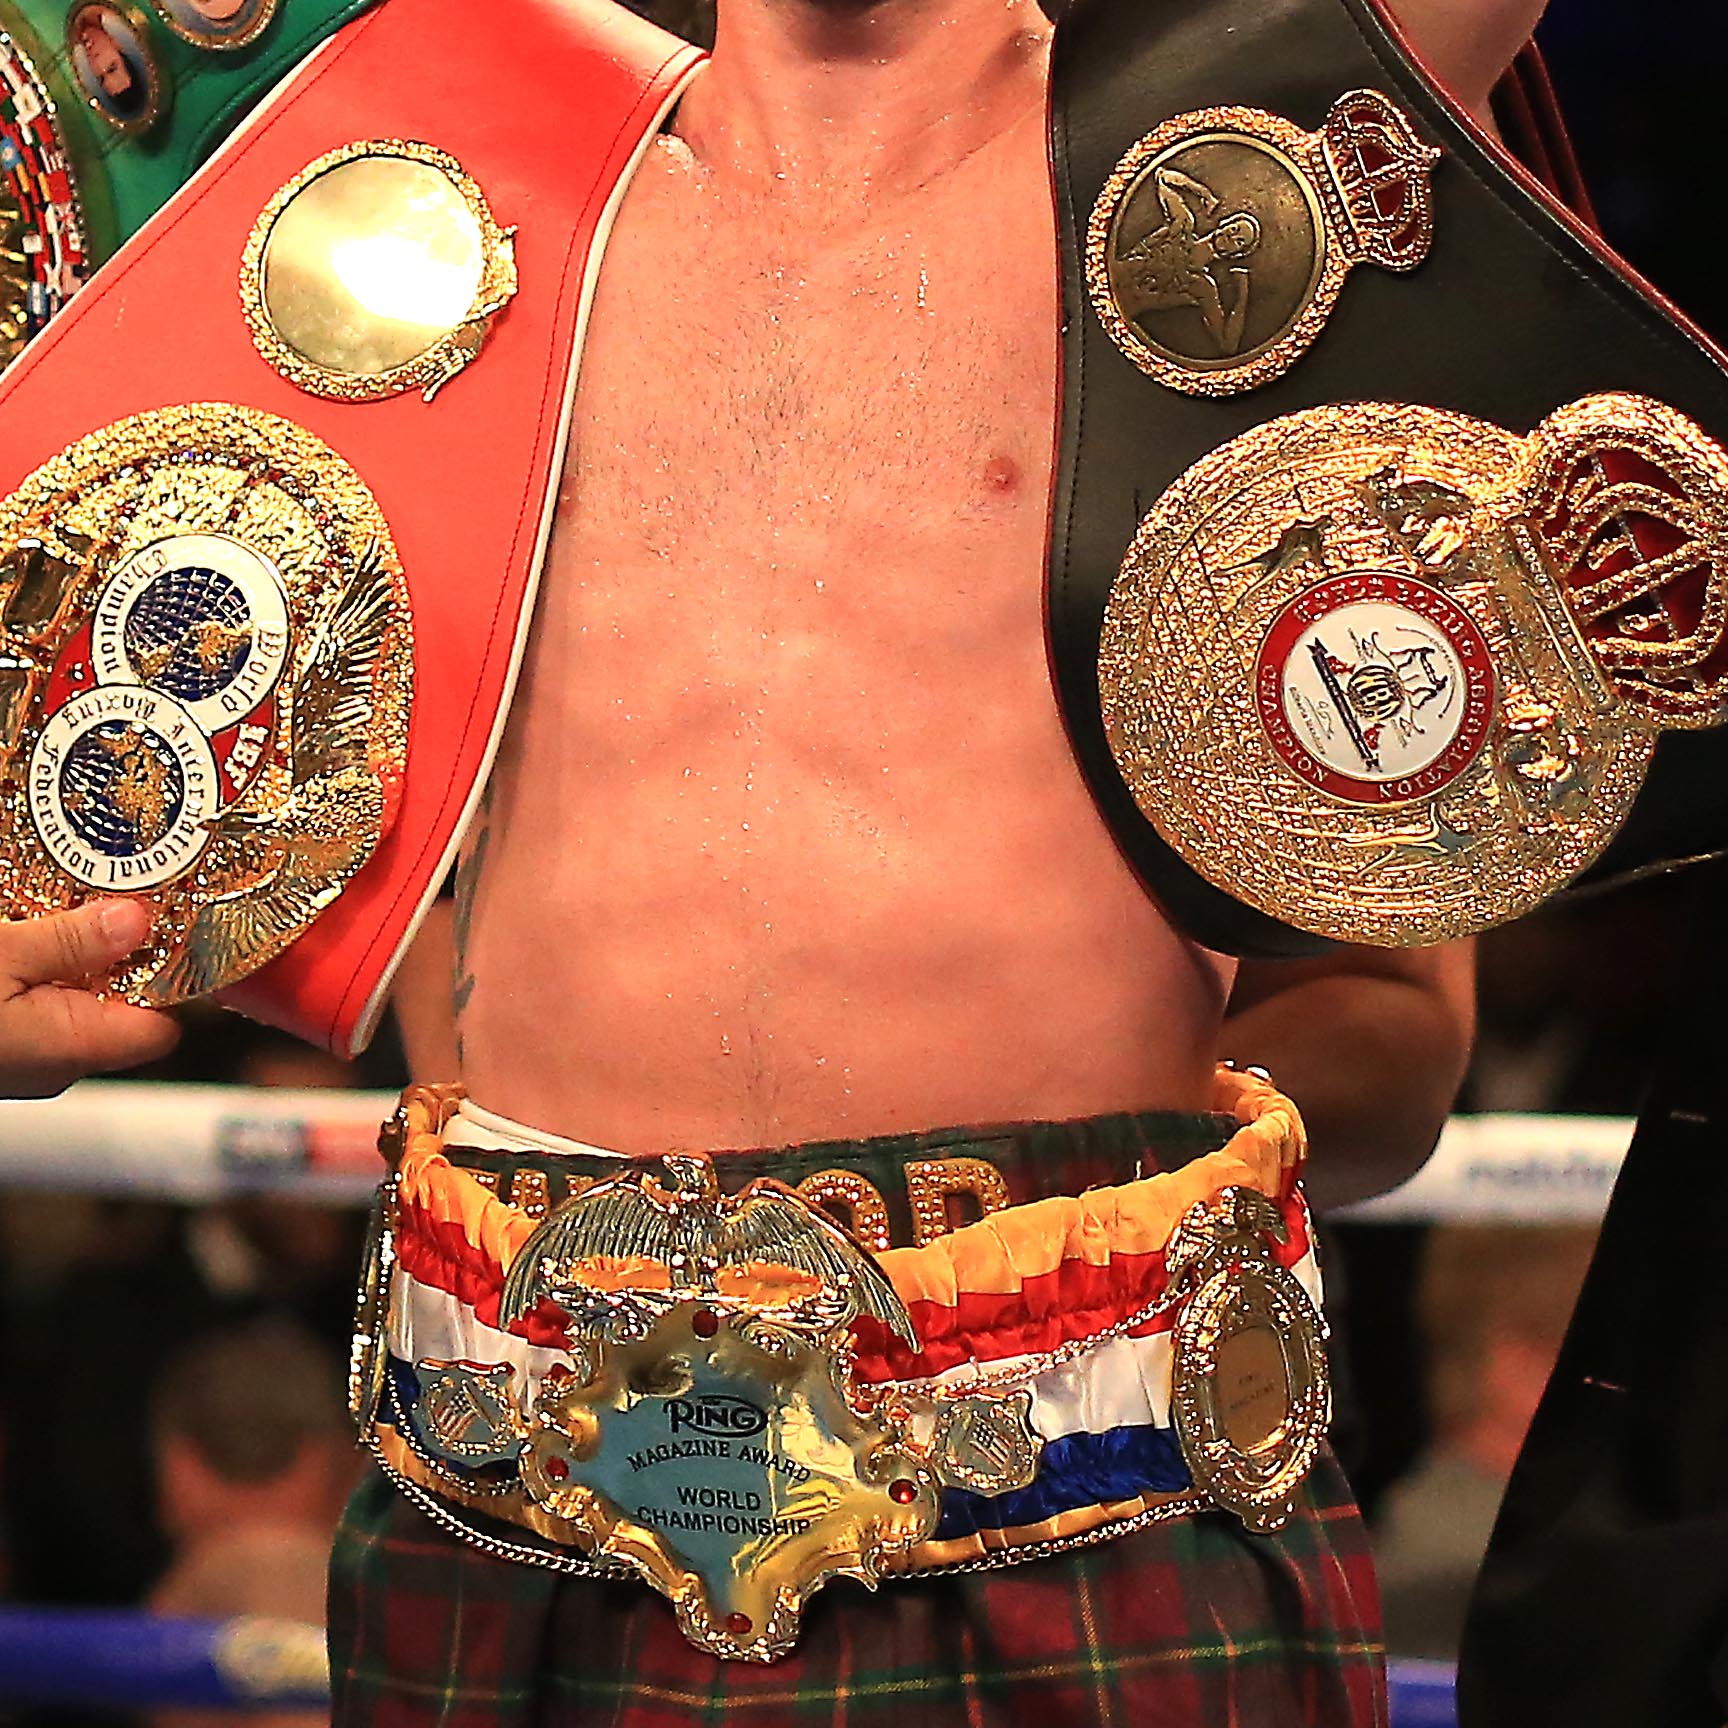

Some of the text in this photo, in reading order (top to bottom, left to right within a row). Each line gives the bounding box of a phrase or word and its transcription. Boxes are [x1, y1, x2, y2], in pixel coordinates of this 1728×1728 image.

[100, 548, 285, 714] World Champion
[223, 722, 270, 790] IBF
[1262, 663, 1329, 783] CHAMPION
[1378, 665, 1487, 800] ASSOCIATION
[35, 694, 205, 882] International Boxing Federation
[663, 1396, 756, 1435] RING
[626, 1440, 811, 1482] MAGAZINE AWARD
[637, 1506, 811, 1536] CHAMPIONSHIP
[677, 1486, 762, 1512] WORLD
